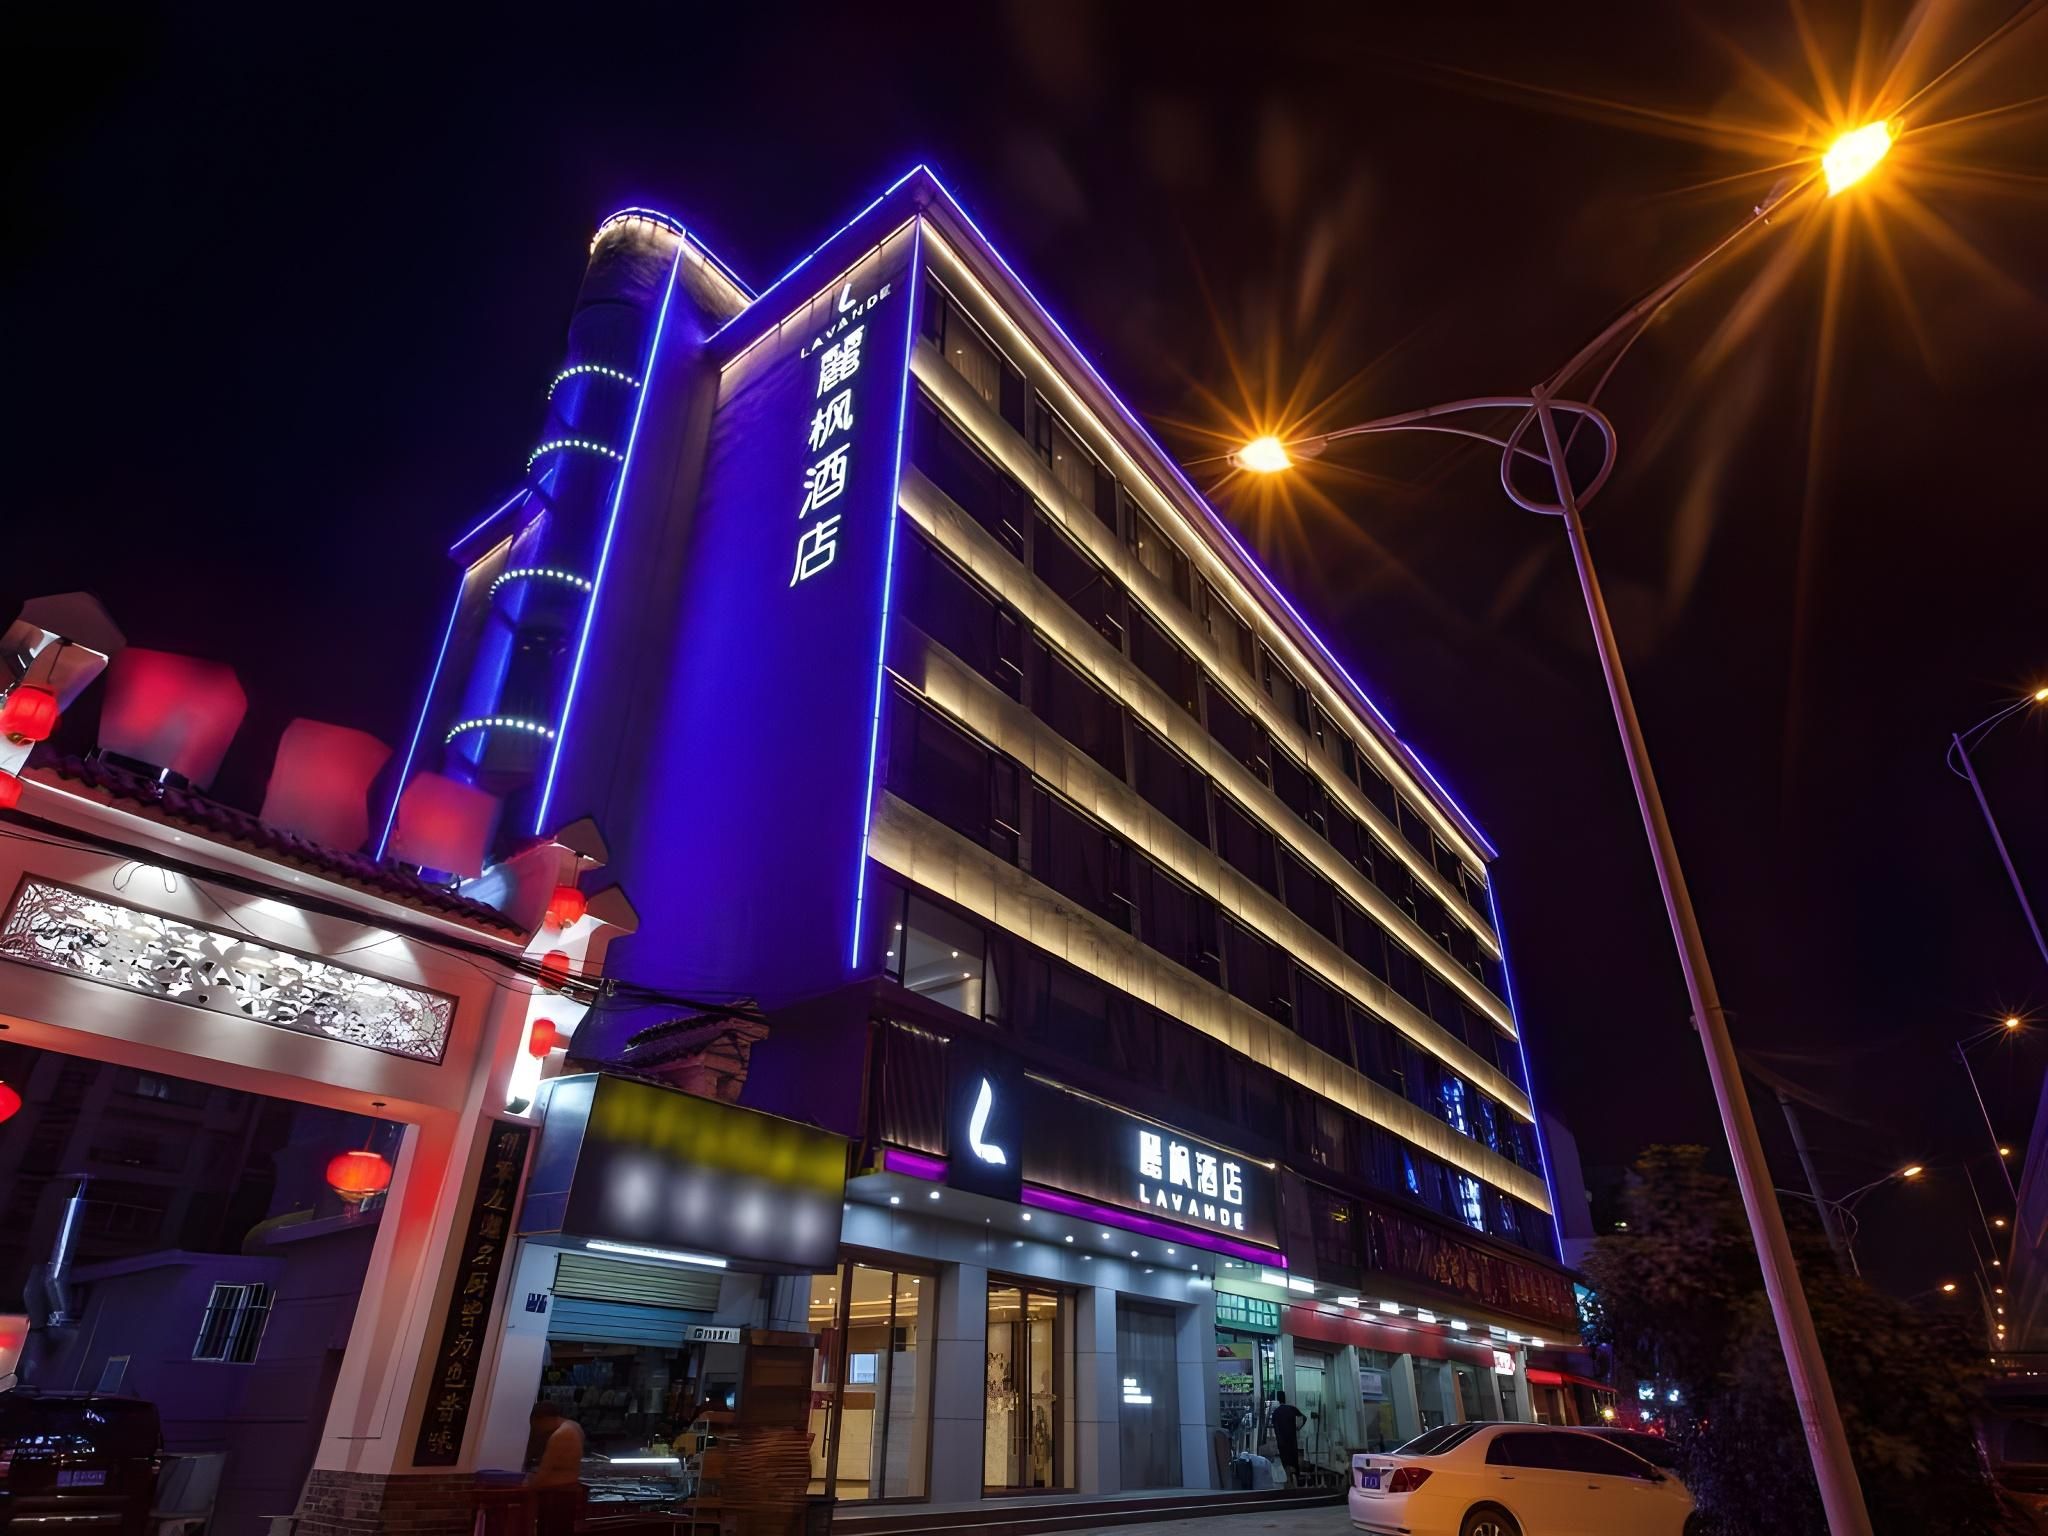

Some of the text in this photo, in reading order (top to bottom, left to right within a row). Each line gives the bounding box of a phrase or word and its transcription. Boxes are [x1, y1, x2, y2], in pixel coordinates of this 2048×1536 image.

[800, 283, 891, 359] LAVANDE
[789, 324, 865, 587] 麗枫酒店
[1139, 1183, 1244, 1231] LAVANDE
